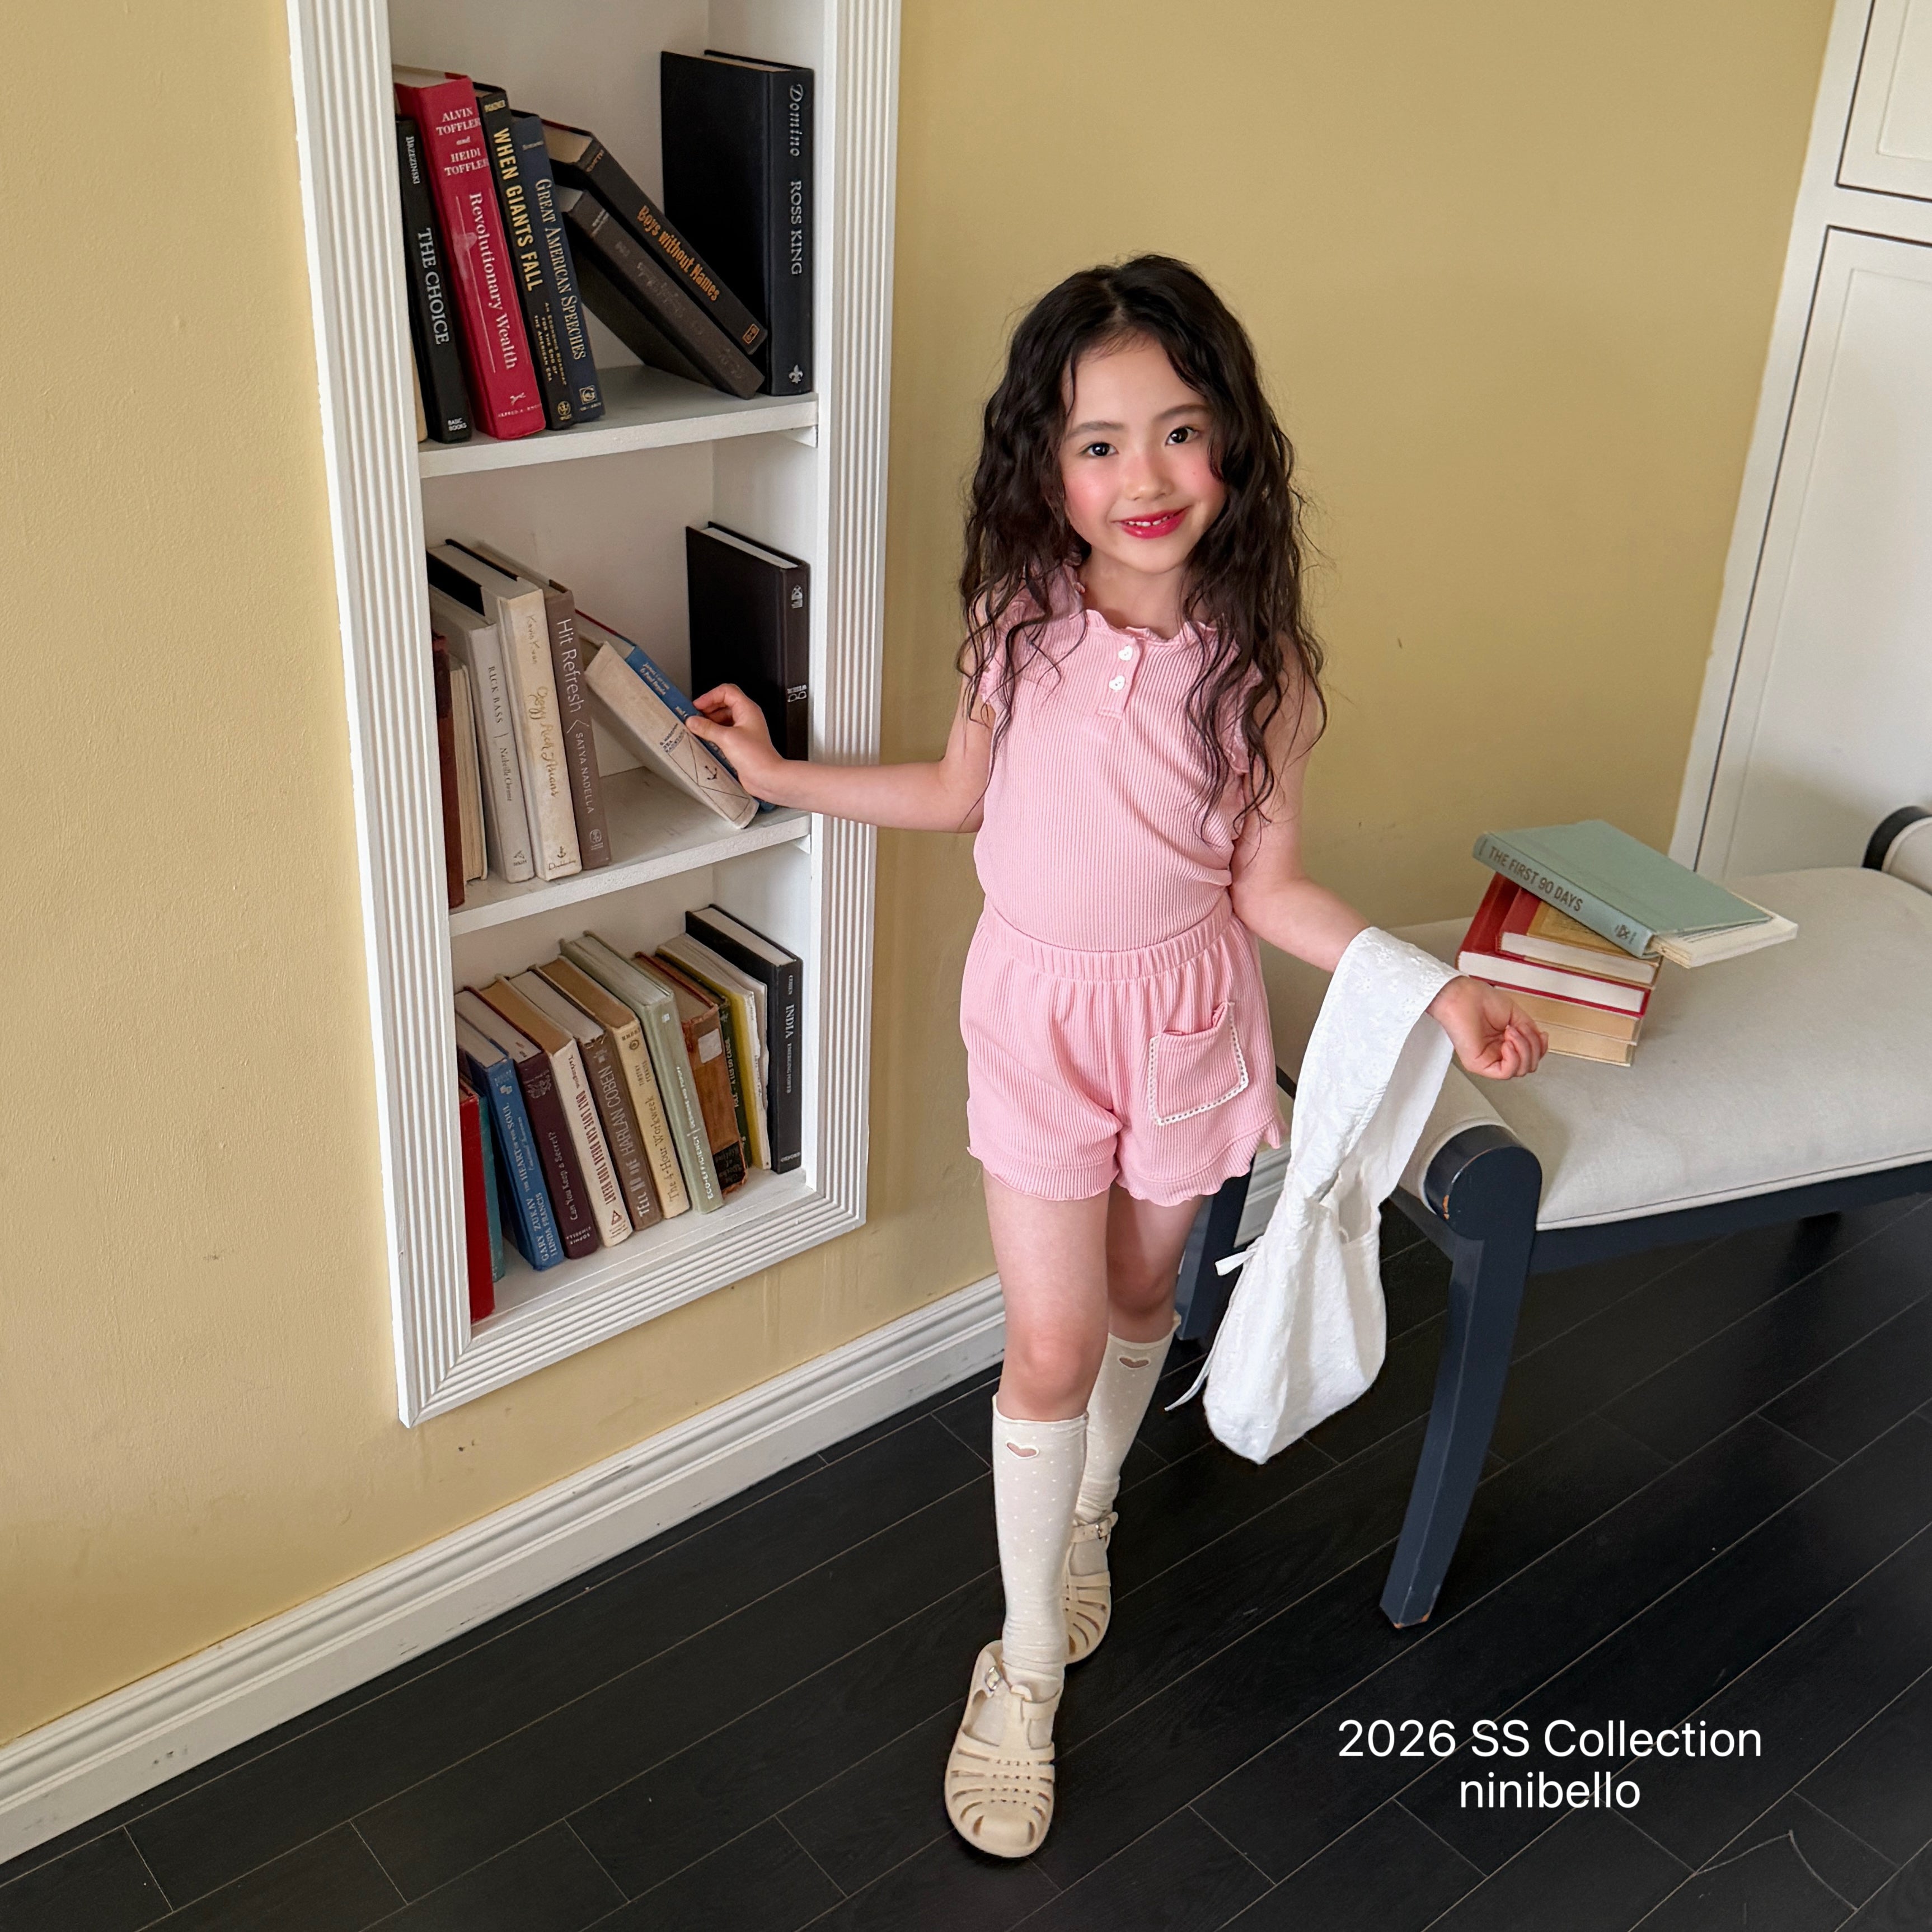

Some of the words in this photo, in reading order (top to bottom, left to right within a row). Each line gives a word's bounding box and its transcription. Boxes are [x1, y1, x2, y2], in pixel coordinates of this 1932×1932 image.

[436, 118, 481, 135] TOFFLER
[442, 107, 473, 122] ALVIN
[790, 84, 803, 157] Domino
[451, 148, 481, 162] HEIDI
[456, 137, 471, 145] and
[494, 128, 519, 180] WHEN
[506, 186, 533, 247] GIANTS
[536, 179, 556, 223] GREAT
[790, 180, 802, 225] ROSS
[418, 227, 436, 269] THE
[545, 228, 571, 293] AMERICAN
[637, 206, 659, 236] Boys
[659, 230, 695, 273] without
[690, 266, 720, 301] Names
[791, 230, 802, 275] KING
[470, 193, 503, 315] Revolutionary
[496, 313, 518, 369] Wealth
[520, 252, 543, 291] FALL
[425, 271, 449, 345] CHOICE
[561, 296, 586, 360] SPEECHES
[557, 618, 573, 646] Hit
[489, 666, 498, 693] RICK
[561, 649, 585, 712] Refresh
[493, 697, 503, 723] BASS
[576, 732, 587, 765] SATYA
[581, 767, 594, 814] NADELLA
[1489, 847, 1509, 866] THE
[1508, 859, 1538, 884] FIRST
[1540, 877, 1554, 894] 90
[1554, 887, 1583, 912] DAYS
[786, 1004, 794, 1039] INDIA
[576, 1090, 589, 1110] ONLY
[598, 1066, 621, 1108] COBEN
[503, 1103, 514, 1129] SOUL
[580, 1108, 595, 1129] LOVE
[610, 1108, 635, 1156] HARLAN
[645, 1095, 664, 1146] Workweek
[586, 1127, 599, 1144] CAN
[514, 1149, 527, 1180] HEART
[589, 1142, 604, 1165] BREAK
[660, 1146, 674, 1179] 4-Hour
[693, 1136, 714, 1199] ECO-EFFICIENCY
[561, 1170, 569, 1189] Keep
[596, 1162, 611, 1184] YOUR
[601, 1182, 616, 1204] HEART
[637, 1192, 649, 1217] TELL
[668, 1181, 679, 1202] The
[526, 1199, 544, 1231] ZUKAV
[533, 1193, 549, 1226] FRANCIS
[537, 1235, 549, 1261] GARY
[545, 1227, 556, 1253] LINDA
